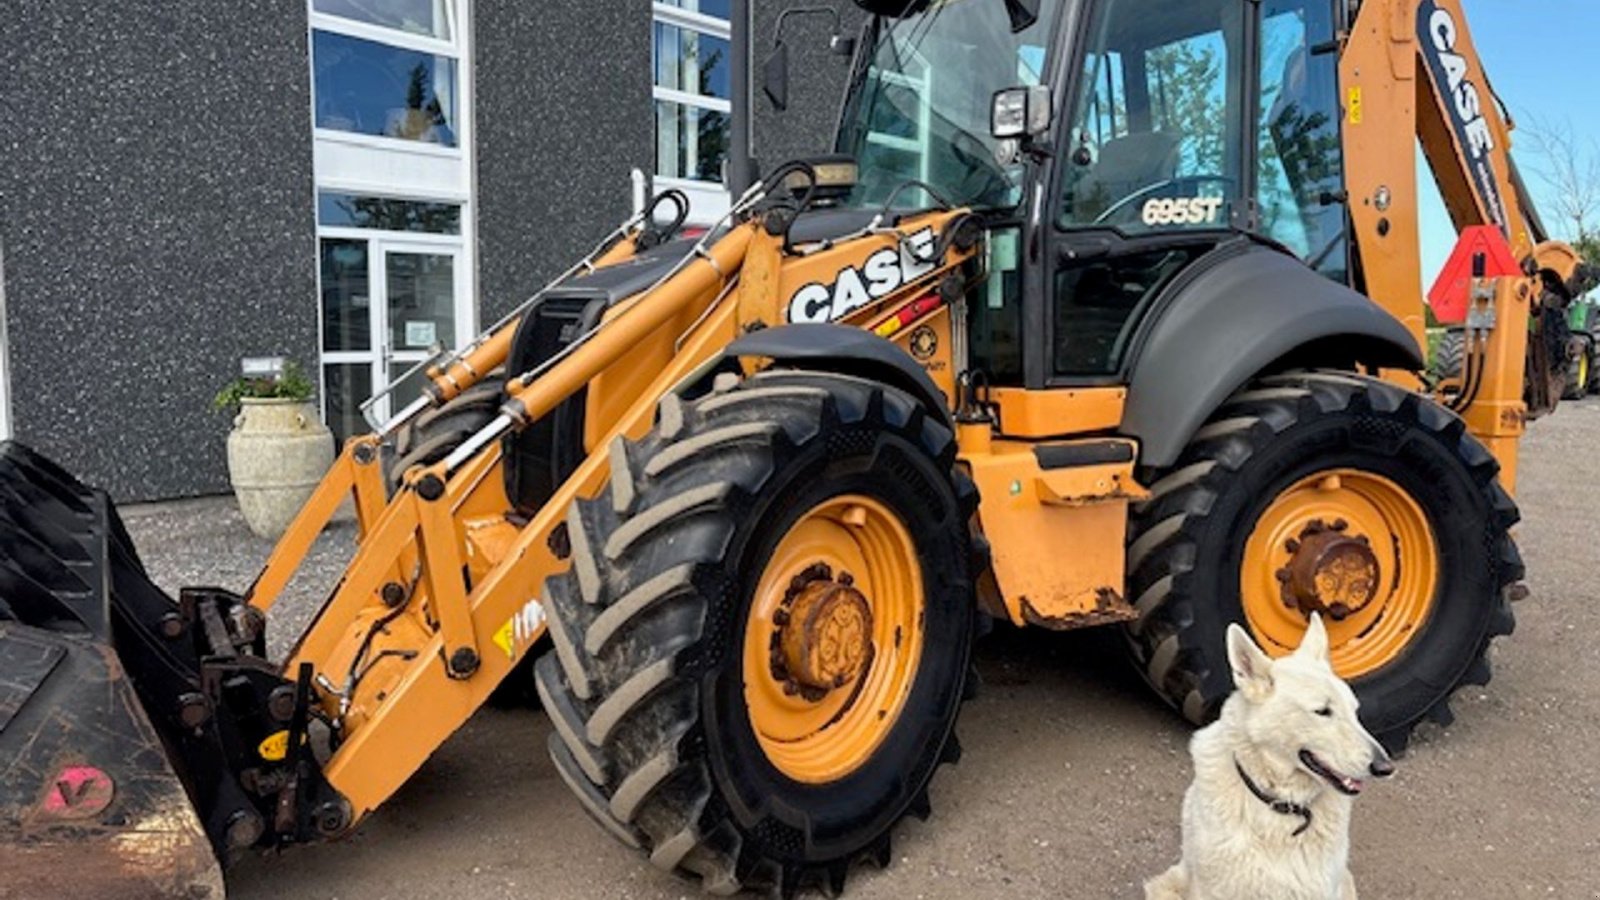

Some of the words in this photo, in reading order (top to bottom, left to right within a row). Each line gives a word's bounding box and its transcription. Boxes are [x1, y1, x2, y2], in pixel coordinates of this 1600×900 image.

[1429, 9, 1494, 159] CASE
[1142, 197, 1223, 225] 695ST
[788, 226, 937, 324] CASE
